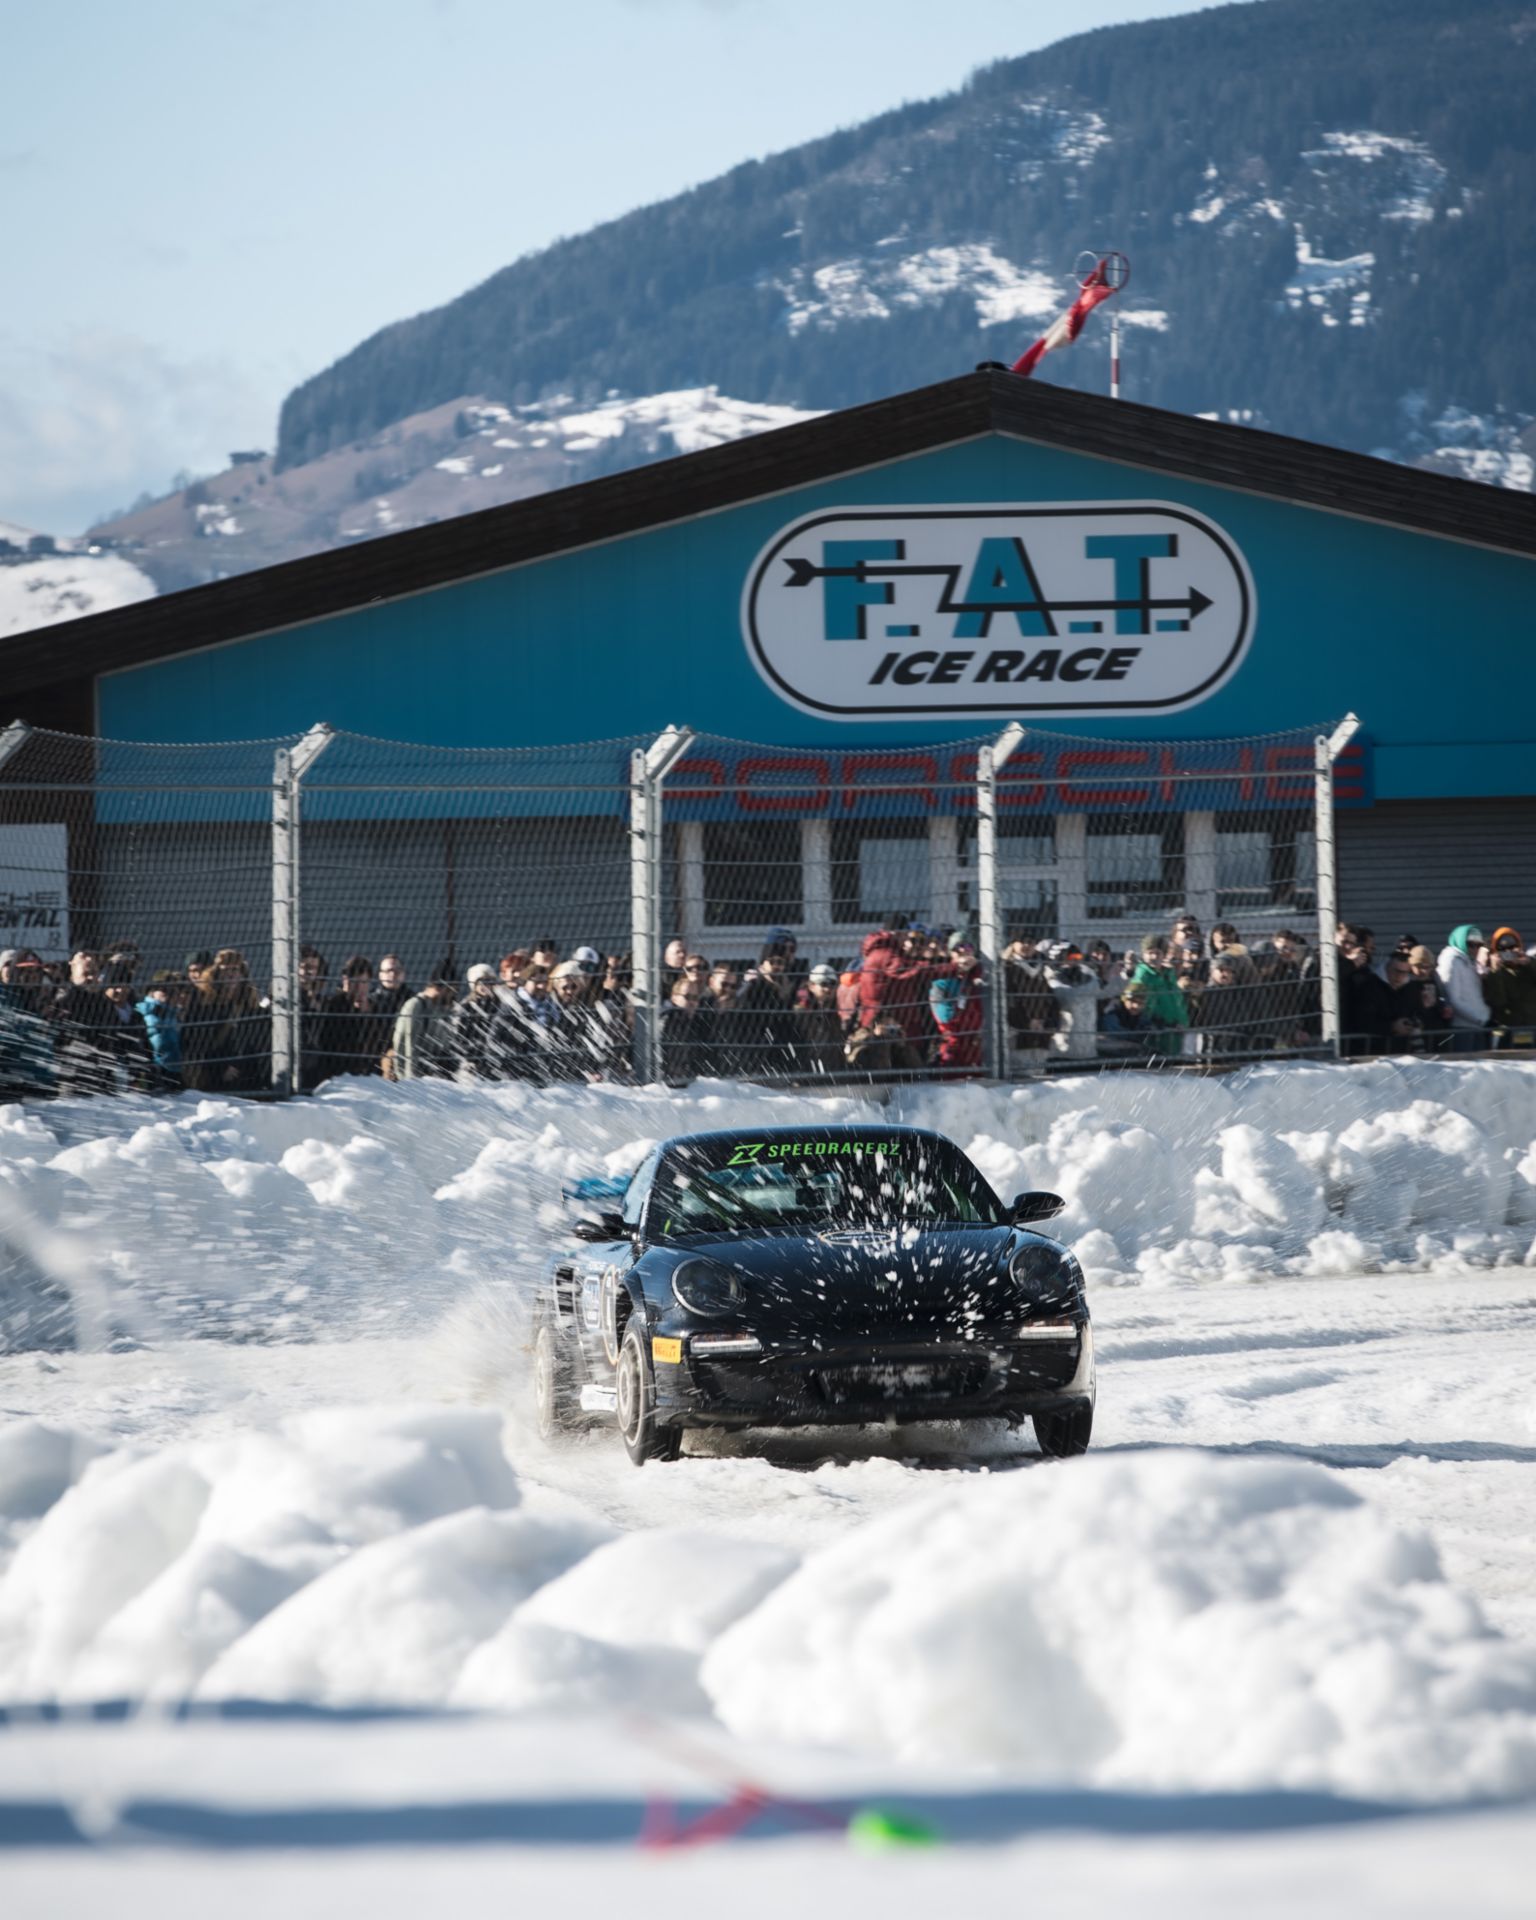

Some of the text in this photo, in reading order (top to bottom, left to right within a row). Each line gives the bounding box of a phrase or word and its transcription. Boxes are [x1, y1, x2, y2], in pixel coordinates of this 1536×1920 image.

[822, 533, 1191, 640] F.A.T.
[868, 647, 1143, 685] ICE RACE
[767, 1142, 901, 1158] SPEEDRACERZ
